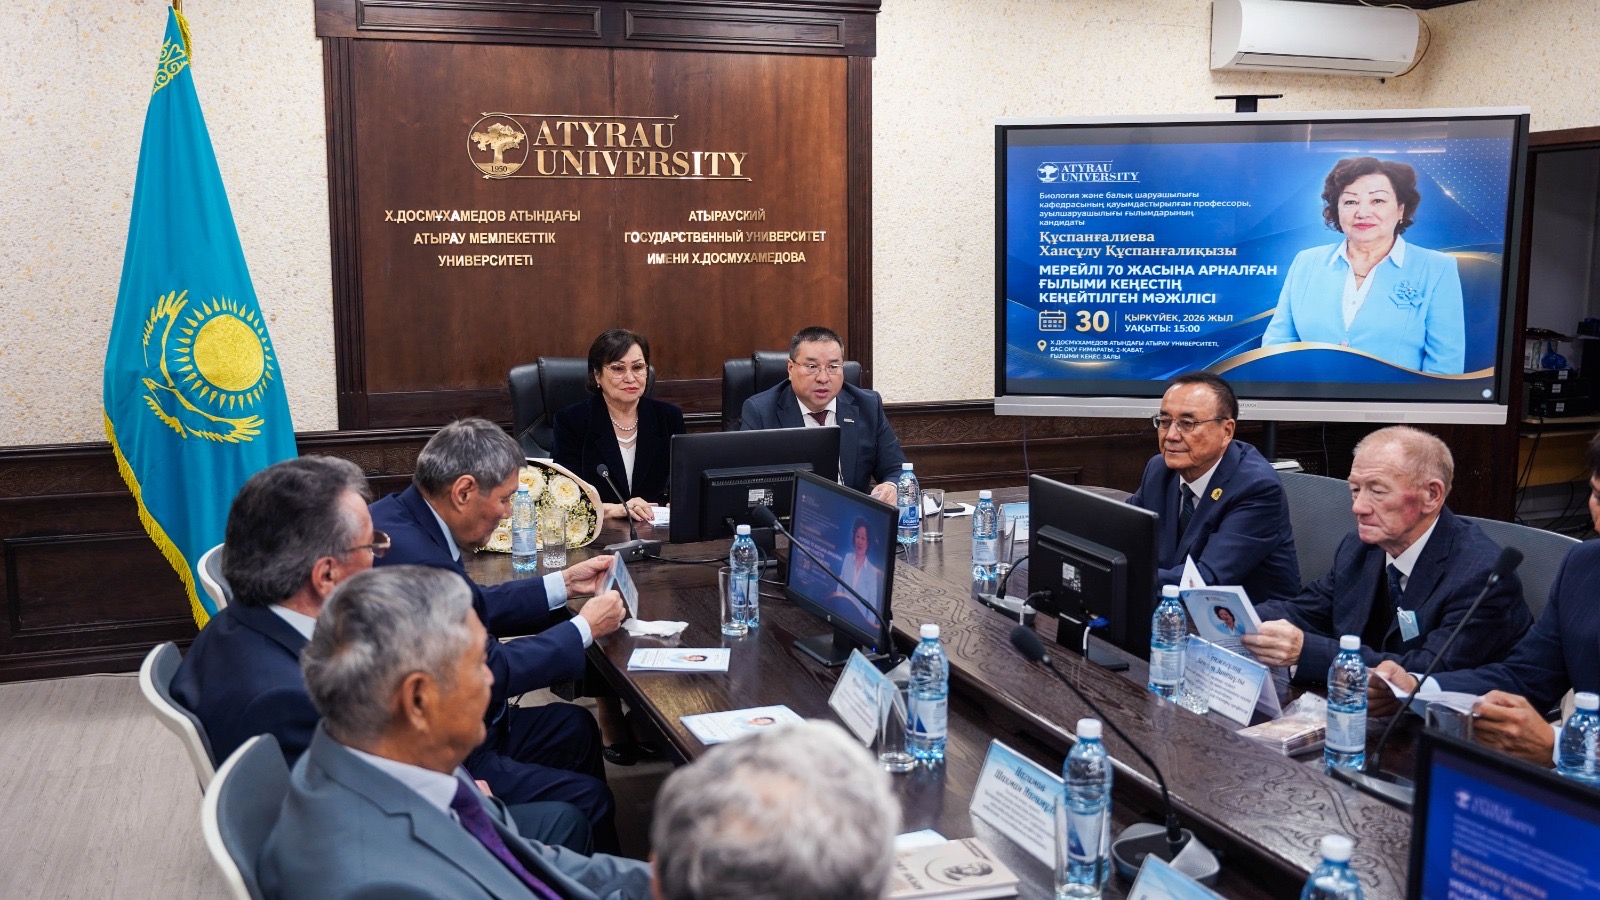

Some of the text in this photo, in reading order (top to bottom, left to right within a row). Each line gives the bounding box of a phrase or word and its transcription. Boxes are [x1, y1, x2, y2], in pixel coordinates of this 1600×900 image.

[533, 121, 675, 148] ATYRAU
[537, 150, 748, 177] UNIVERSITY
[1061, 163, 1112, 173] ATYRAU
[1061, 172, 1140, 182] UNIVERSITY
[1105, 191, 1133, 200] балық
[1193, 199, 1252, 208] профессоры,
[509, 209, 581, 223] АТЫНДАҒЫ
[688, 208, 766, 222] АТЫРАУСКИЙ
[413, 232, 556, 245] АТЫРАУ МЕМЛЕКЕТТІК
[624, 230, 827, 245] ГОСУДАРСТВЕННЫЙ УНИВЕРСИТЕТ
[1039, 231, 1155, 244] Құспанғалиева
[1039, 245, 1237, 258] Хансұлу Құспанғалиқызы
[437, 254, 534, 267] УНИВЕРСИТЕТІ
[647, 251, 807, 266] ИМЕНИ Х.ДОСМУХАМЕДОВА
[1039, 263, 1278, 276] МЕРЕЙЛІ 70 ЖАСЫНА АРНАЛҒАН
[1039, 279, 1182, 291] ҒЫЛЫМИ КЕҢЕСТІҢ
[1039, 291, 1216, 304] КЕҢЕЙТІЛГЕН МӘЖІЛІСІ
[1075, 310, 1110, 333] 30
[1183, 313, 1206, 323] 2026
[1207, 313, 1234, 323] ЖЫЛ
[1124, 324, 1200, 334] УАҚЫТЫ: 15:00
